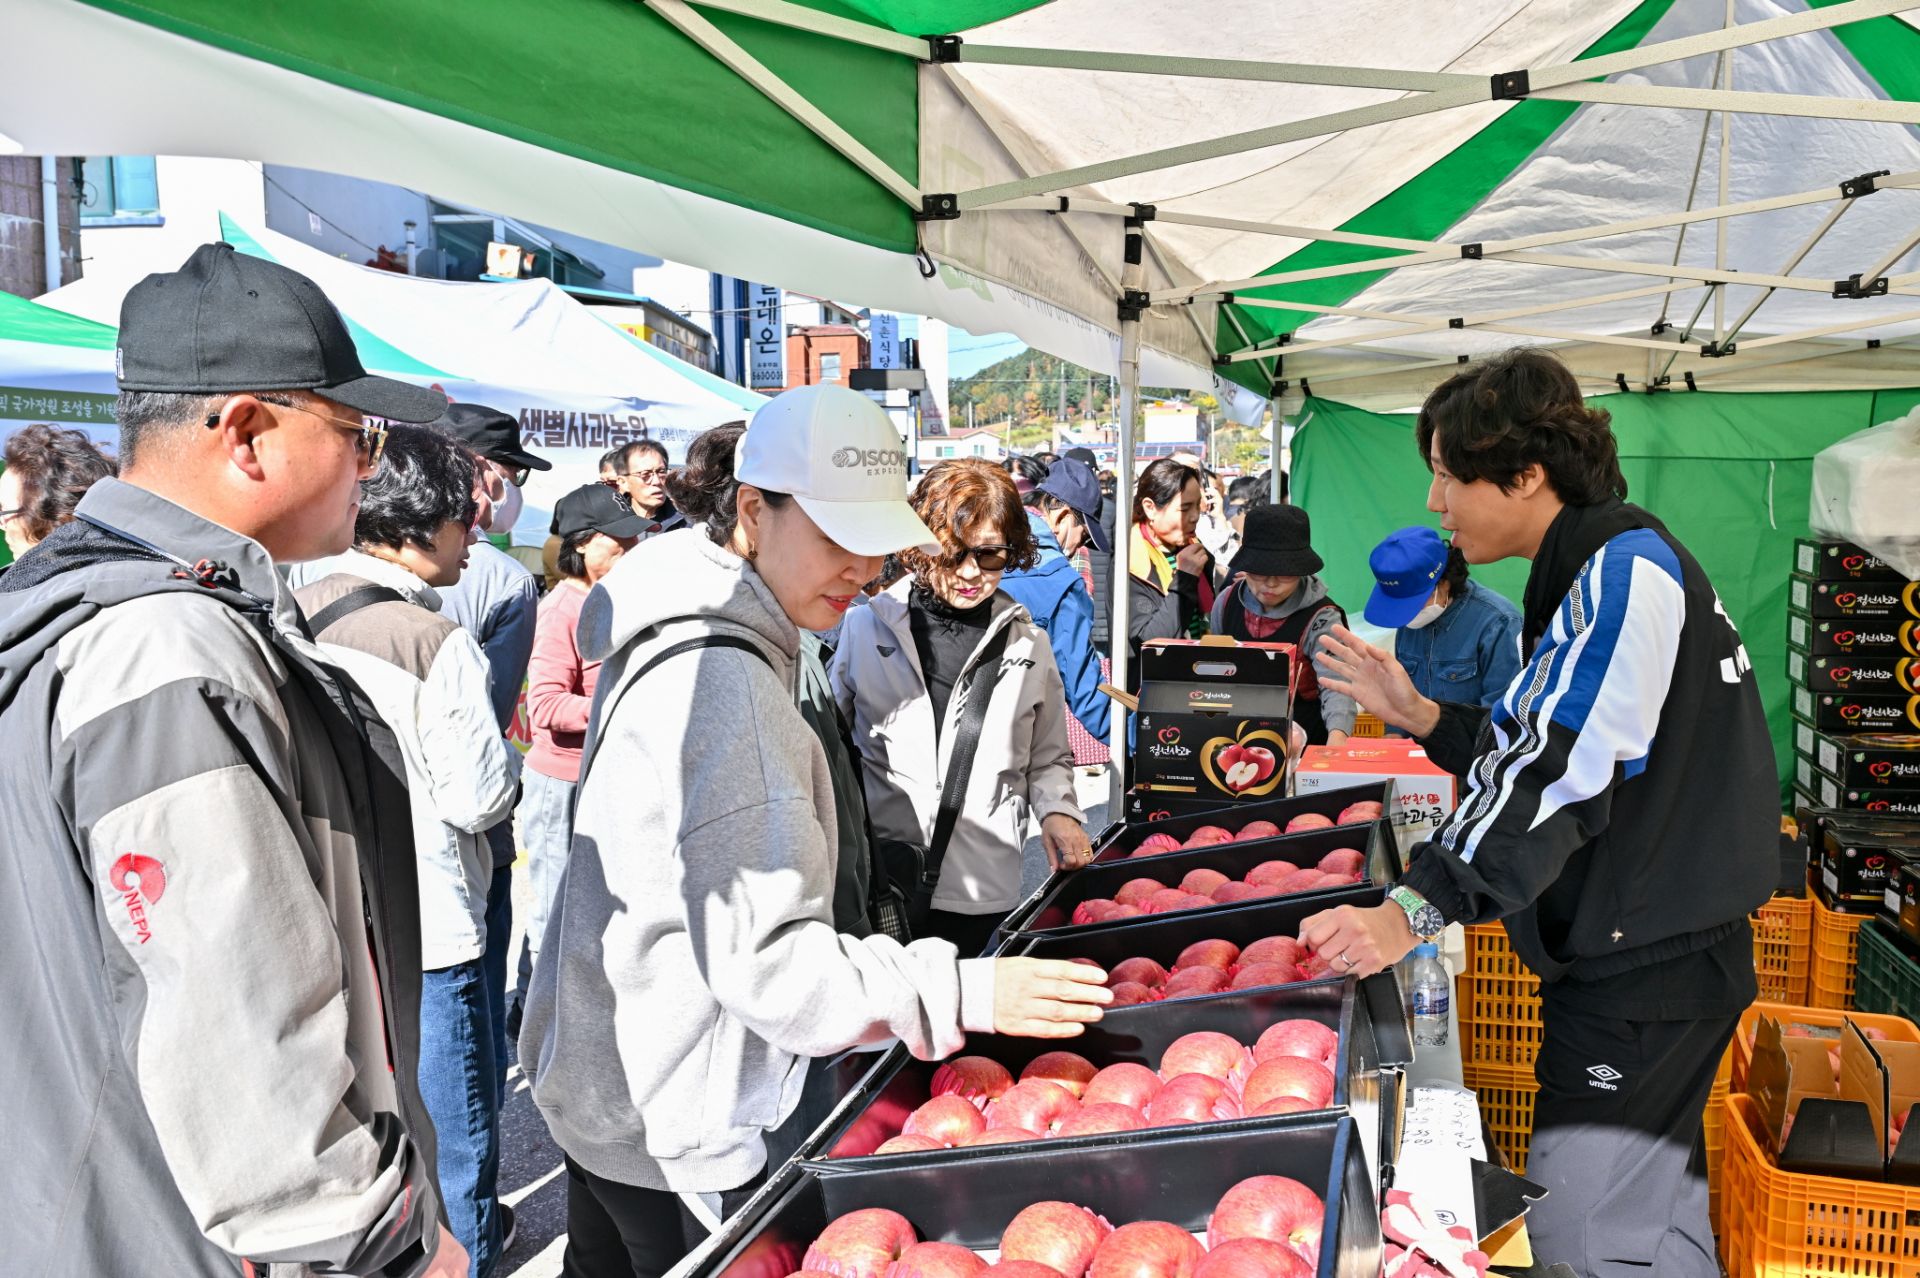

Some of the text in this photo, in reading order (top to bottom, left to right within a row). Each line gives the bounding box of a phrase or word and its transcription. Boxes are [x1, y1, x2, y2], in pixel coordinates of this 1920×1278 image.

[12, 396, 58, 415] 국가정원
[62, 400, 93, 418] 조성을
[1400, 792, 1425, 805] 선한
[123, 891, 152, 944] NEPA
[1588, 1079, 1618, 1091] umbro
